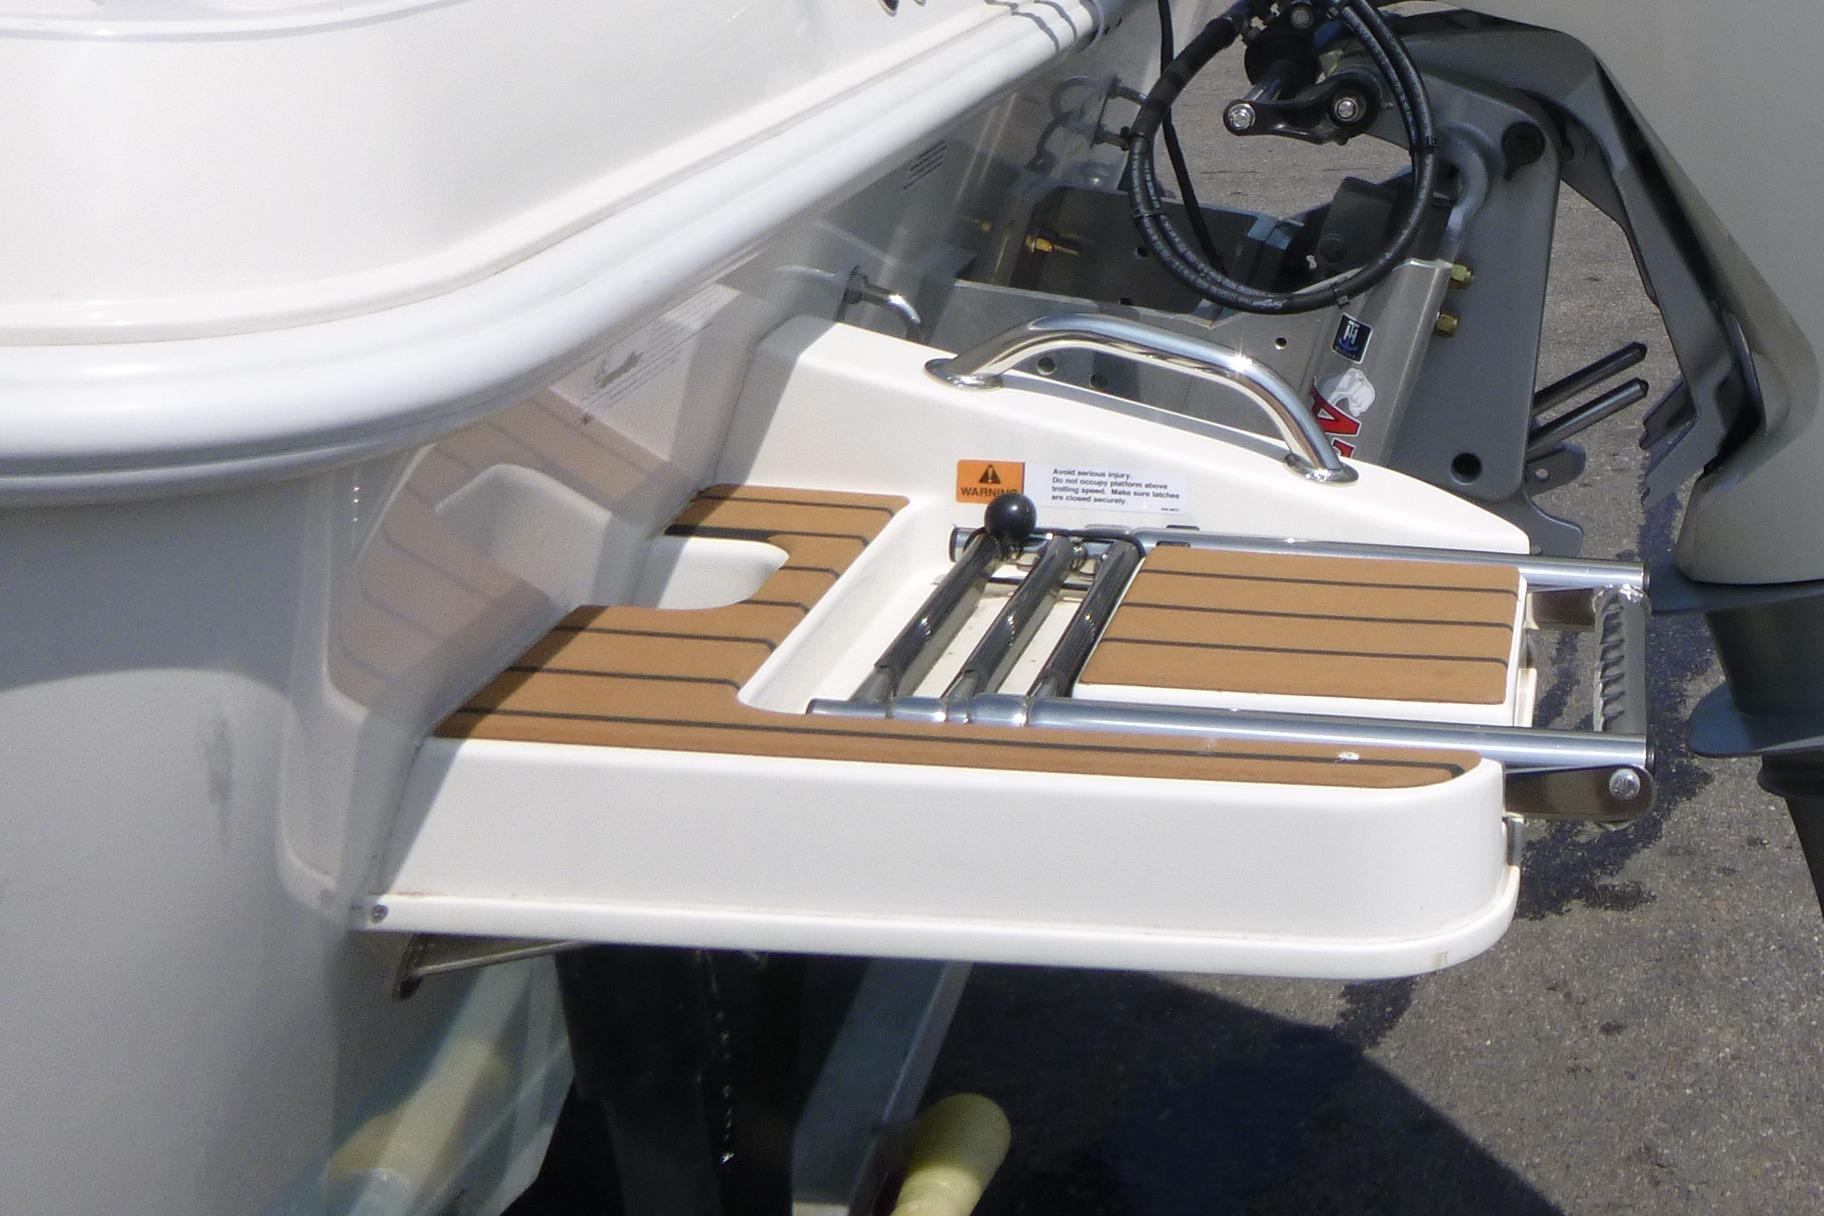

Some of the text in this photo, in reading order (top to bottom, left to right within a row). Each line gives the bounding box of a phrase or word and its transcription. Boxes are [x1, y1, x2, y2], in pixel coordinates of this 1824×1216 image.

[1053, 468, 1133, 480] Avoid serious injury.
[1052, 476, 1063, 484] Do
[1080, 479, 1108, 487] occupy
[1110, 480, 1143, 489] platform
[1144, 482, 1168, 490] above
[1052, 486, 1079, 494] trolling
[1111, 488, 1131, 496] Make
[1152, 491, 1180, 499] latches
[1065, 494, 1091, 503] closed
[1093, 496, 1128, 505] securely.
